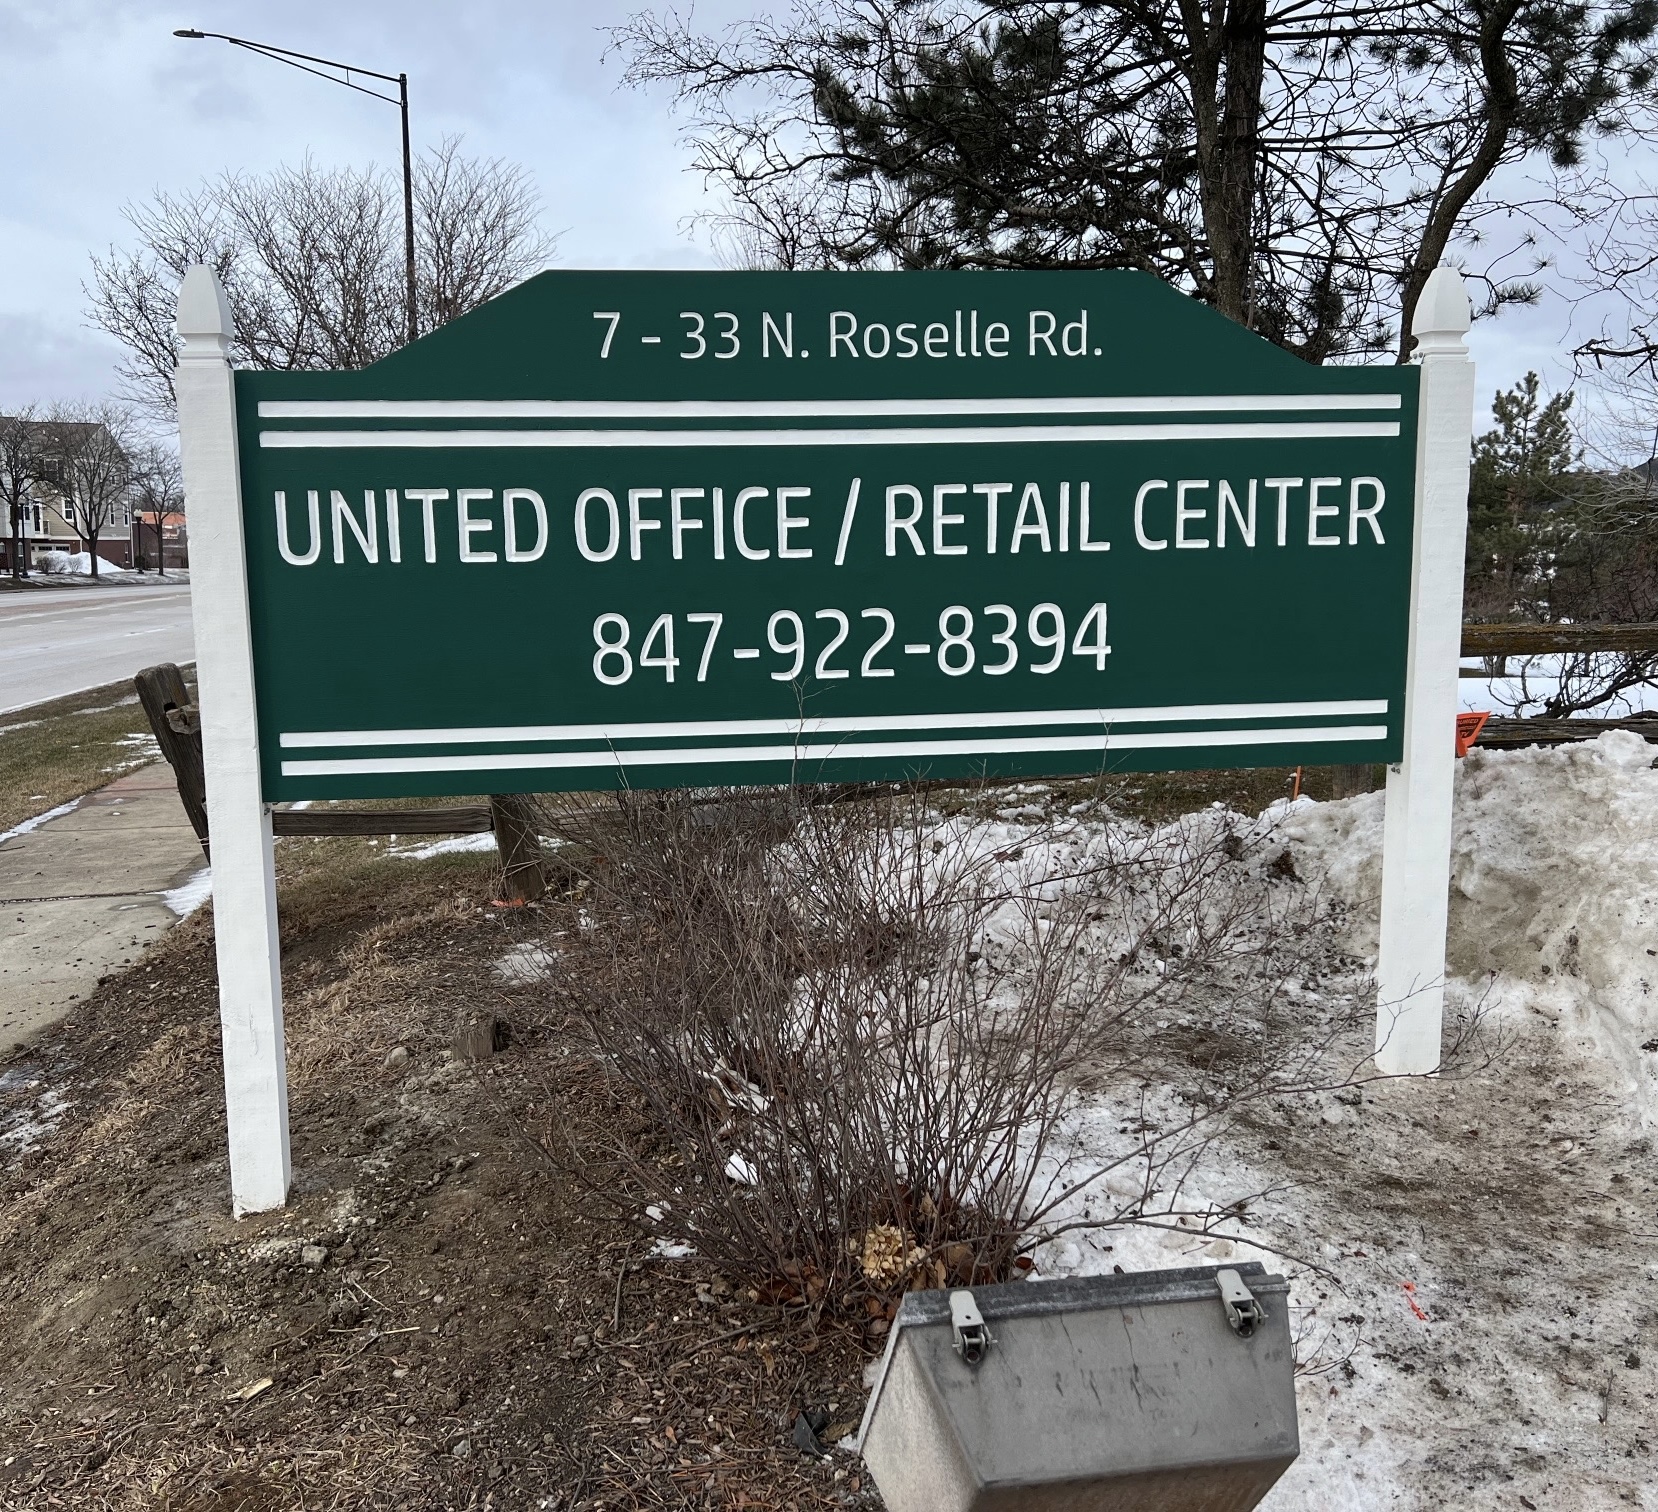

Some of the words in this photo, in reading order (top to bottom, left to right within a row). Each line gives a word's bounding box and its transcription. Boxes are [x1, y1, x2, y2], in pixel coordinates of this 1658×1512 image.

[592, 311, 621, 359] 7
[679, 311, 740, 359] 33
[762, 311, 810, 358] N.
[828, 310, 1011, 359] Roselle
[1028, 309, 1103, 357] Rd.
[273, 487, 549, 567] UNITED
[573, 486, 813, 563] OFFICE
[834, 477, 861, 566] /
[885, 481, 1112, 557] RETAIL
[1133, 476, 1386, 551] CENTER
[592, 602, 1112, 686] 847-922-8394
